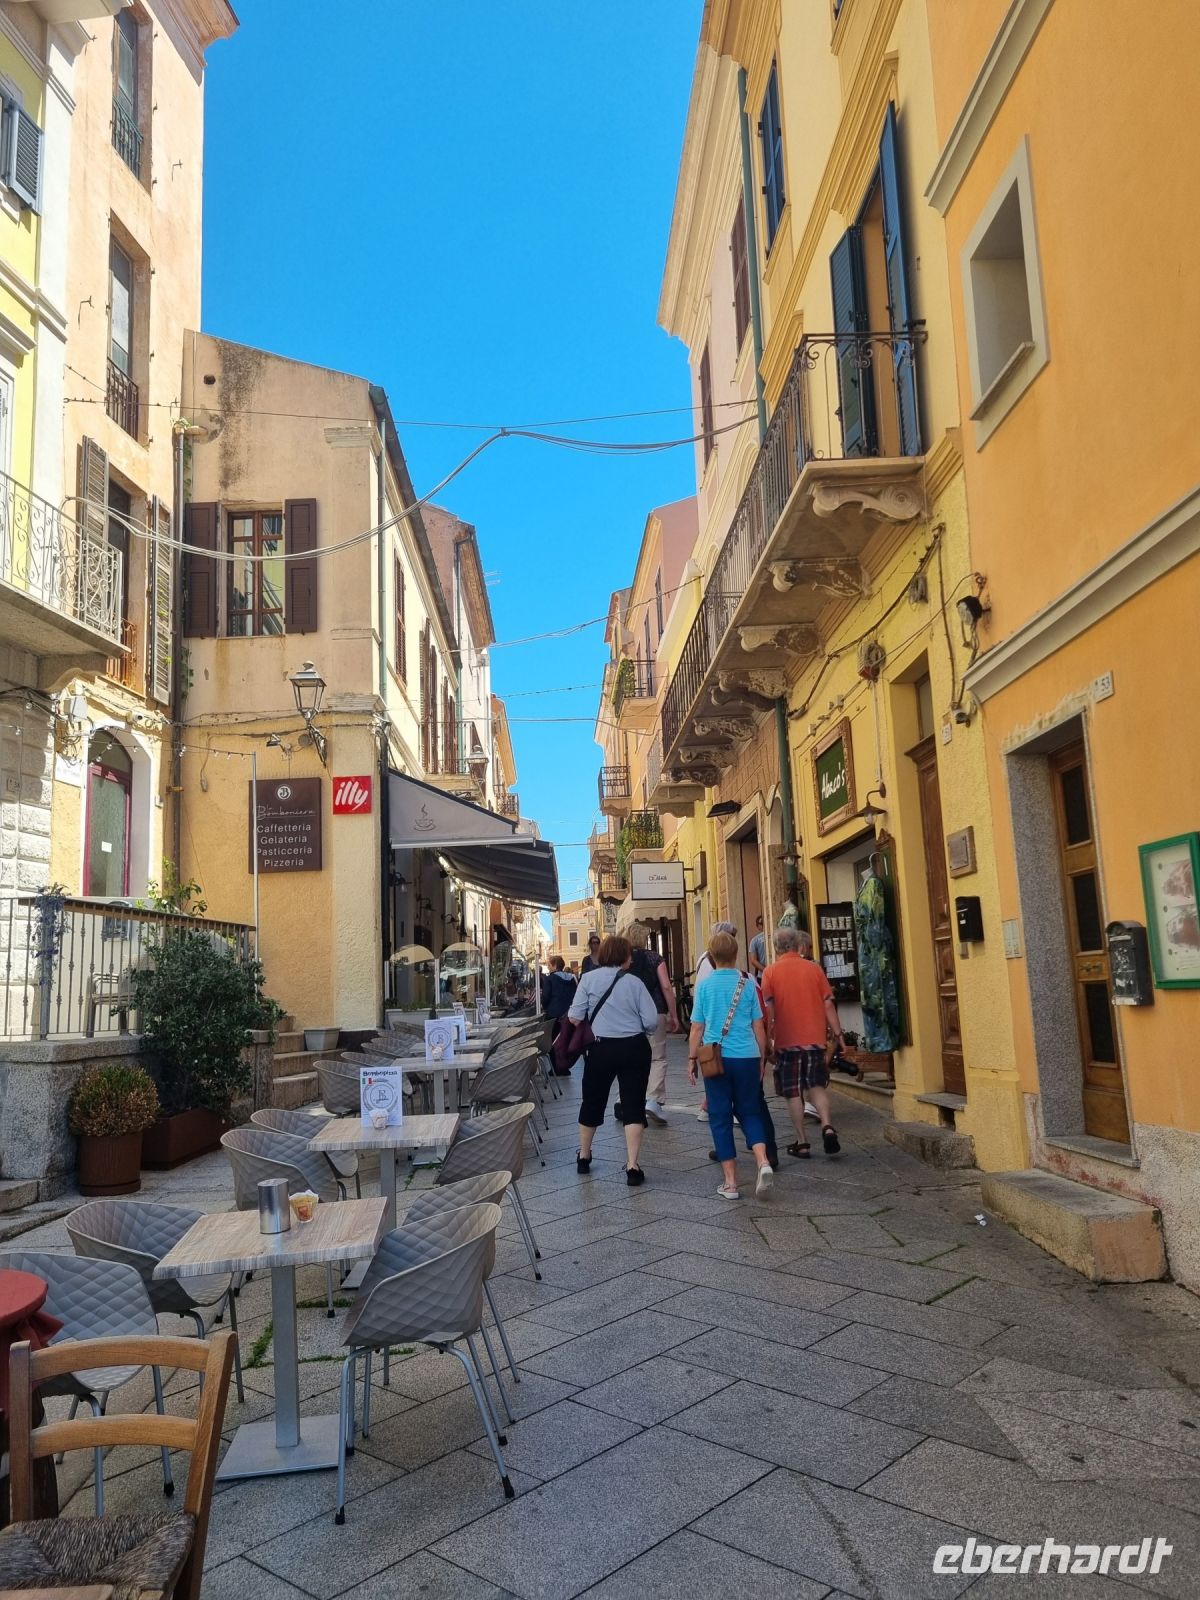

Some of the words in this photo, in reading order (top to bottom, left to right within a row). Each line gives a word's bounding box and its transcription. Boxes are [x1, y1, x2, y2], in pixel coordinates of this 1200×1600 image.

[821, 761, 845, 801] Abaco's
[335, 781, 369, 811] illy
[256, 823, 312, 833] Caffetteria
[260, 835, 308, 845] Gelateria
[256, 846, 313, 856] Pasticceria
[264, 858, 304, 867] Pizzeria
